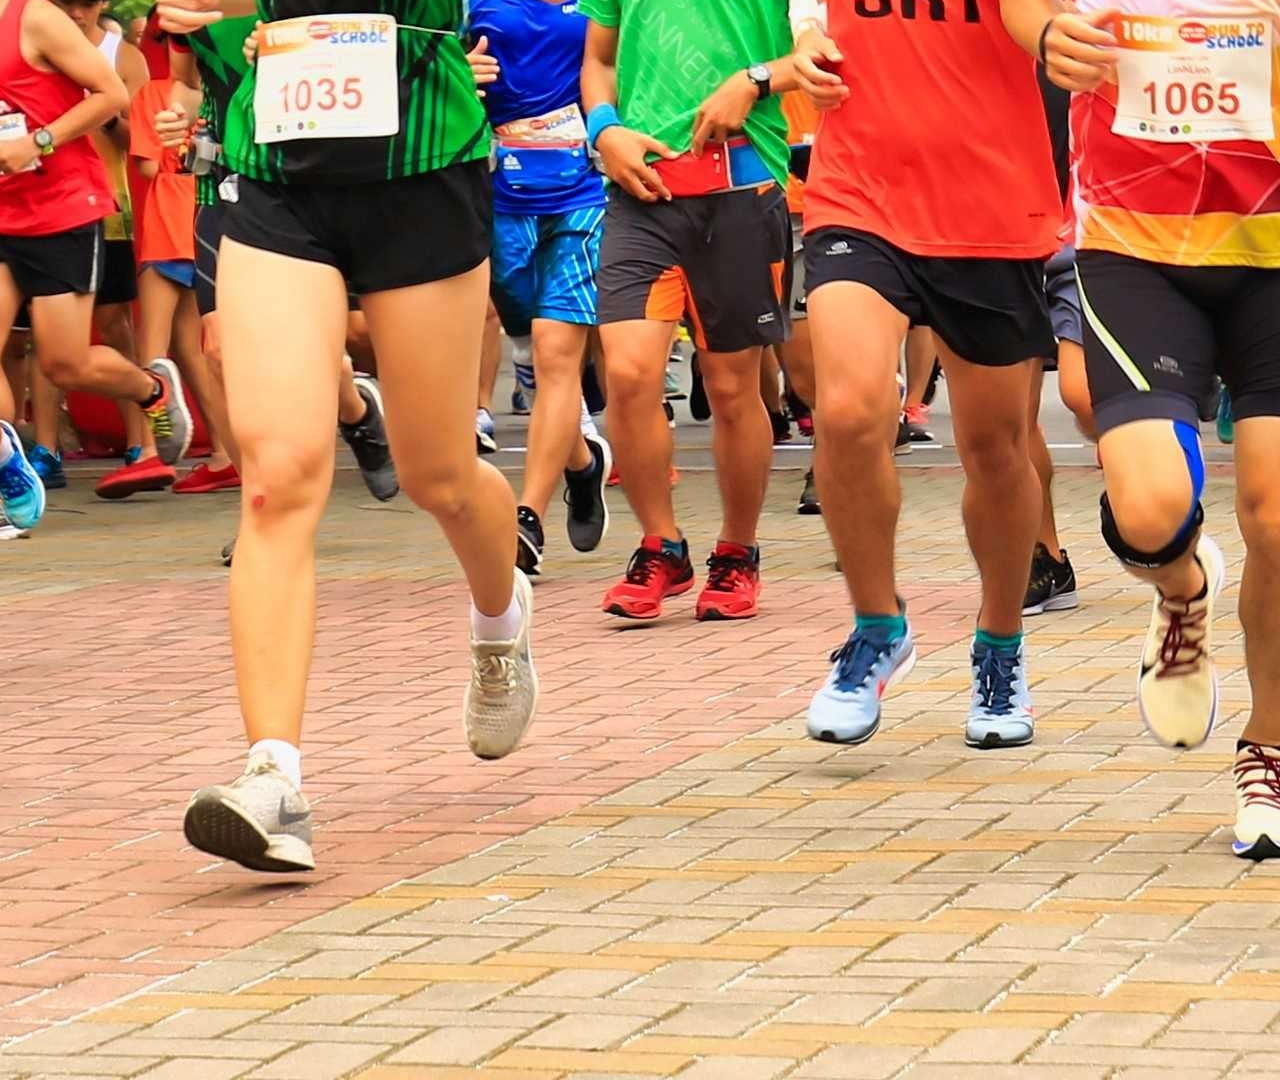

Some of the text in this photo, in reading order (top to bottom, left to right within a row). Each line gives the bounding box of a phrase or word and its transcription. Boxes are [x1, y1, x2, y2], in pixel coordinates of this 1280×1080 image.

[330, 30, 388, 44] SCHOOL
[1207, 24, 1240, 38] RUN
[1246, 22, 1265, 36] TO
[1206, 34, 1264, 49] SCHOOL
[280, 77, 362, 113] 1035
[1142, 81, 1241, 116] 1065
